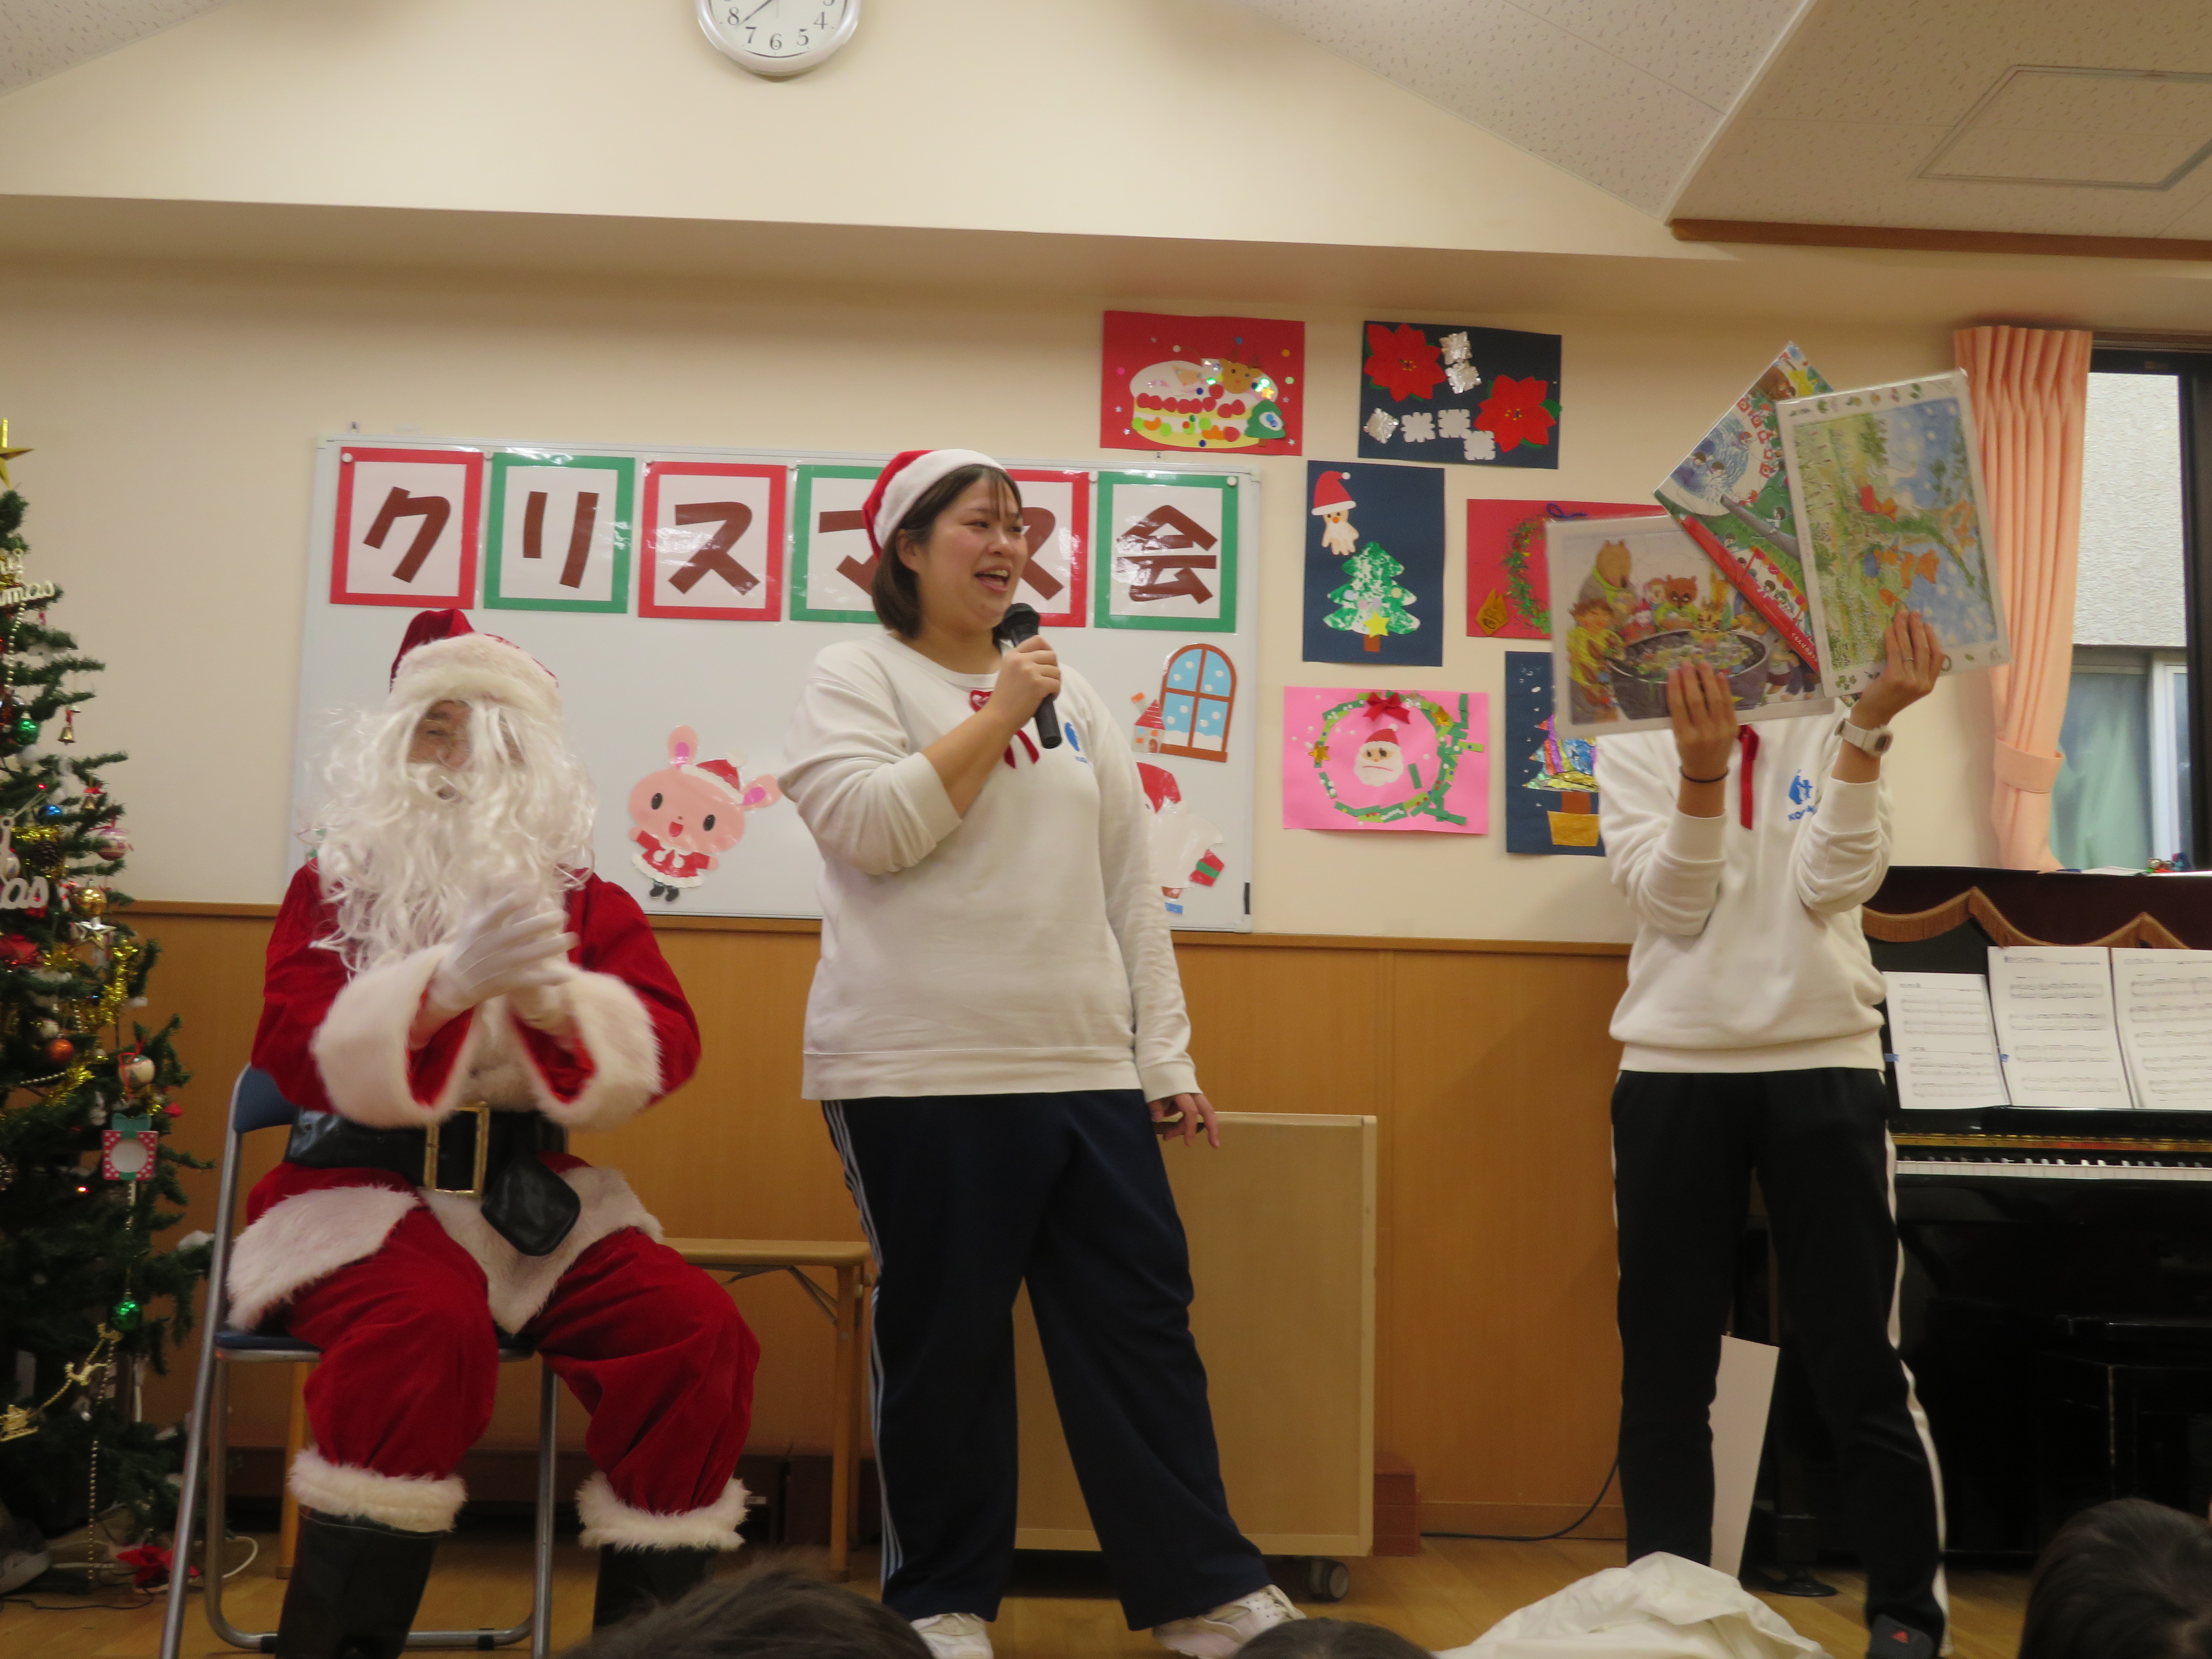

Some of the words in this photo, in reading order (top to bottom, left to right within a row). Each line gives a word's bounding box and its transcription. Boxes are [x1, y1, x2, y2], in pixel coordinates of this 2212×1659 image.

[728, 6, 739, 25] 8
[813, 12, 828, 29] 4
[745, 26, 757, 44] 7
[769, 33, 782, 50] 6
[796, 28, 809, 46] 5
